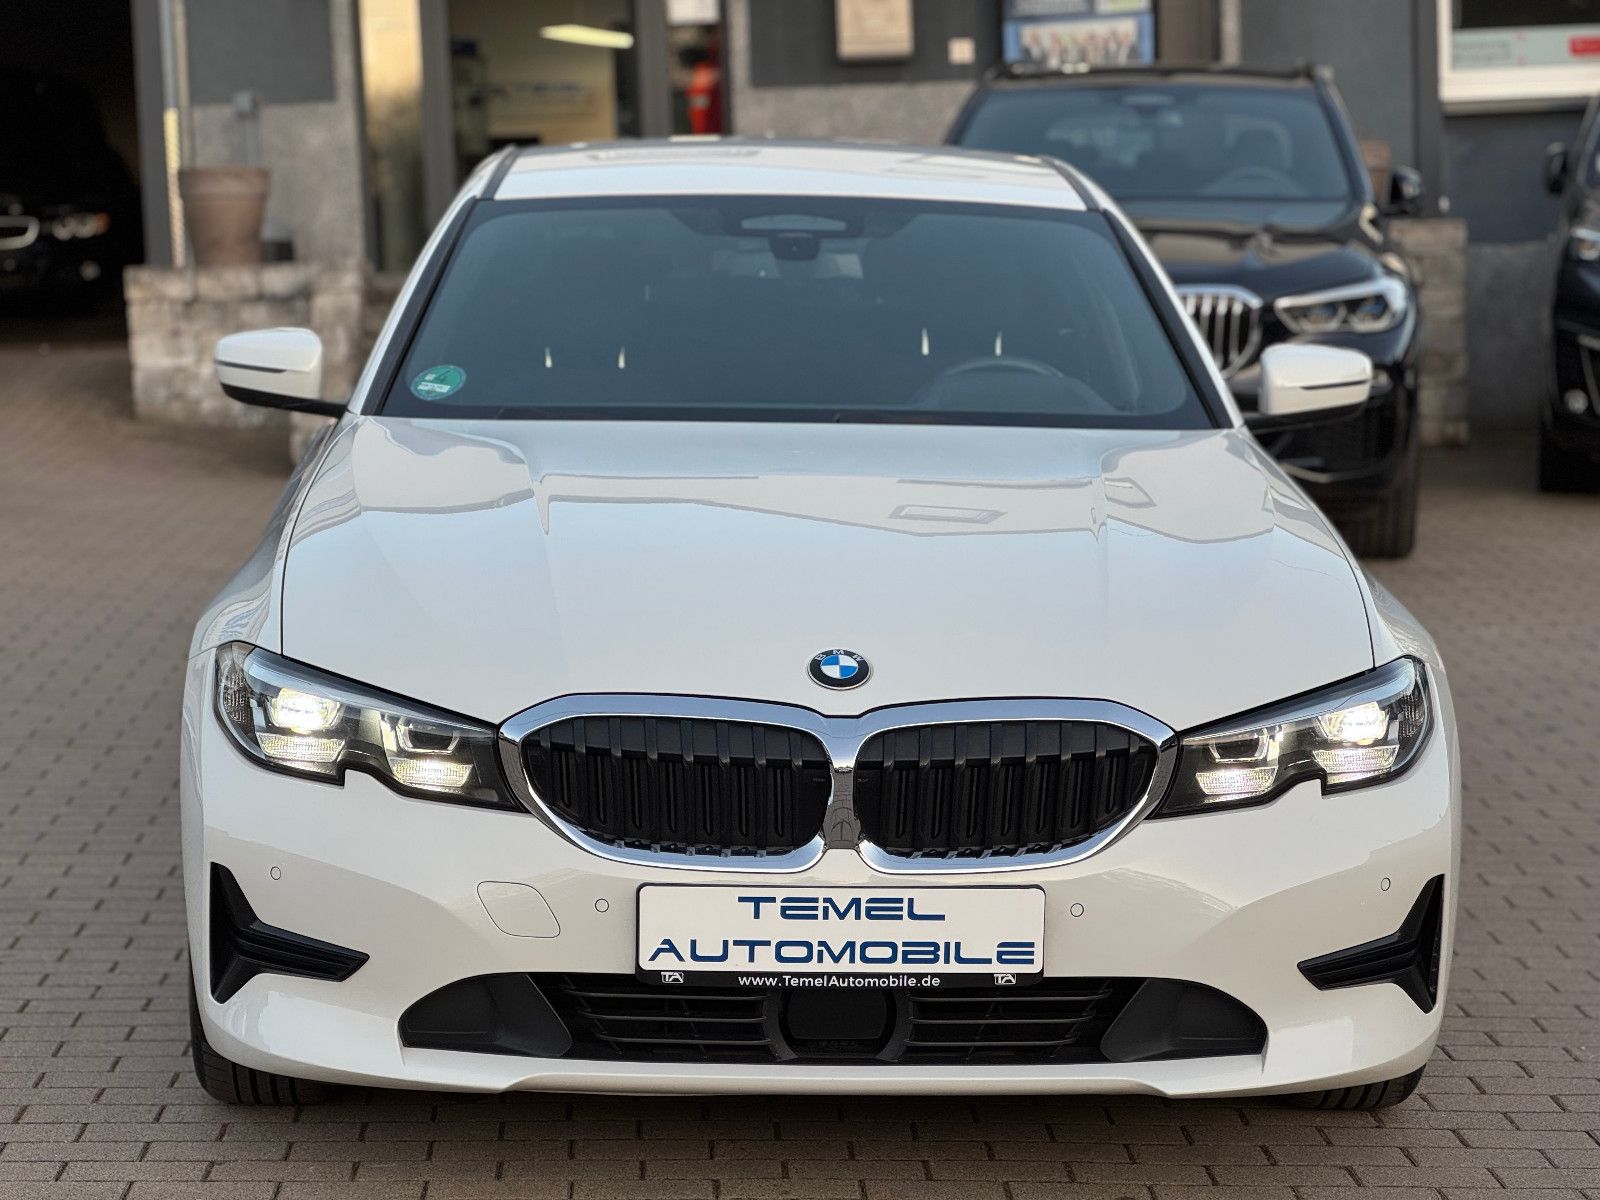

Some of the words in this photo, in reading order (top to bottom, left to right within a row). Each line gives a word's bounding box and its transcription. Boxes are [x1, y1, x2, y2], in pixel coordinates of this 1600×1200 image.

[815, 650, 864, 661] BMW
[738, 896, 946, 921] TEMEL
[648, 938, 1035, 965] AUTOMOBILE
[738, 975, 941, 987] www.TemelAutomobile.de
